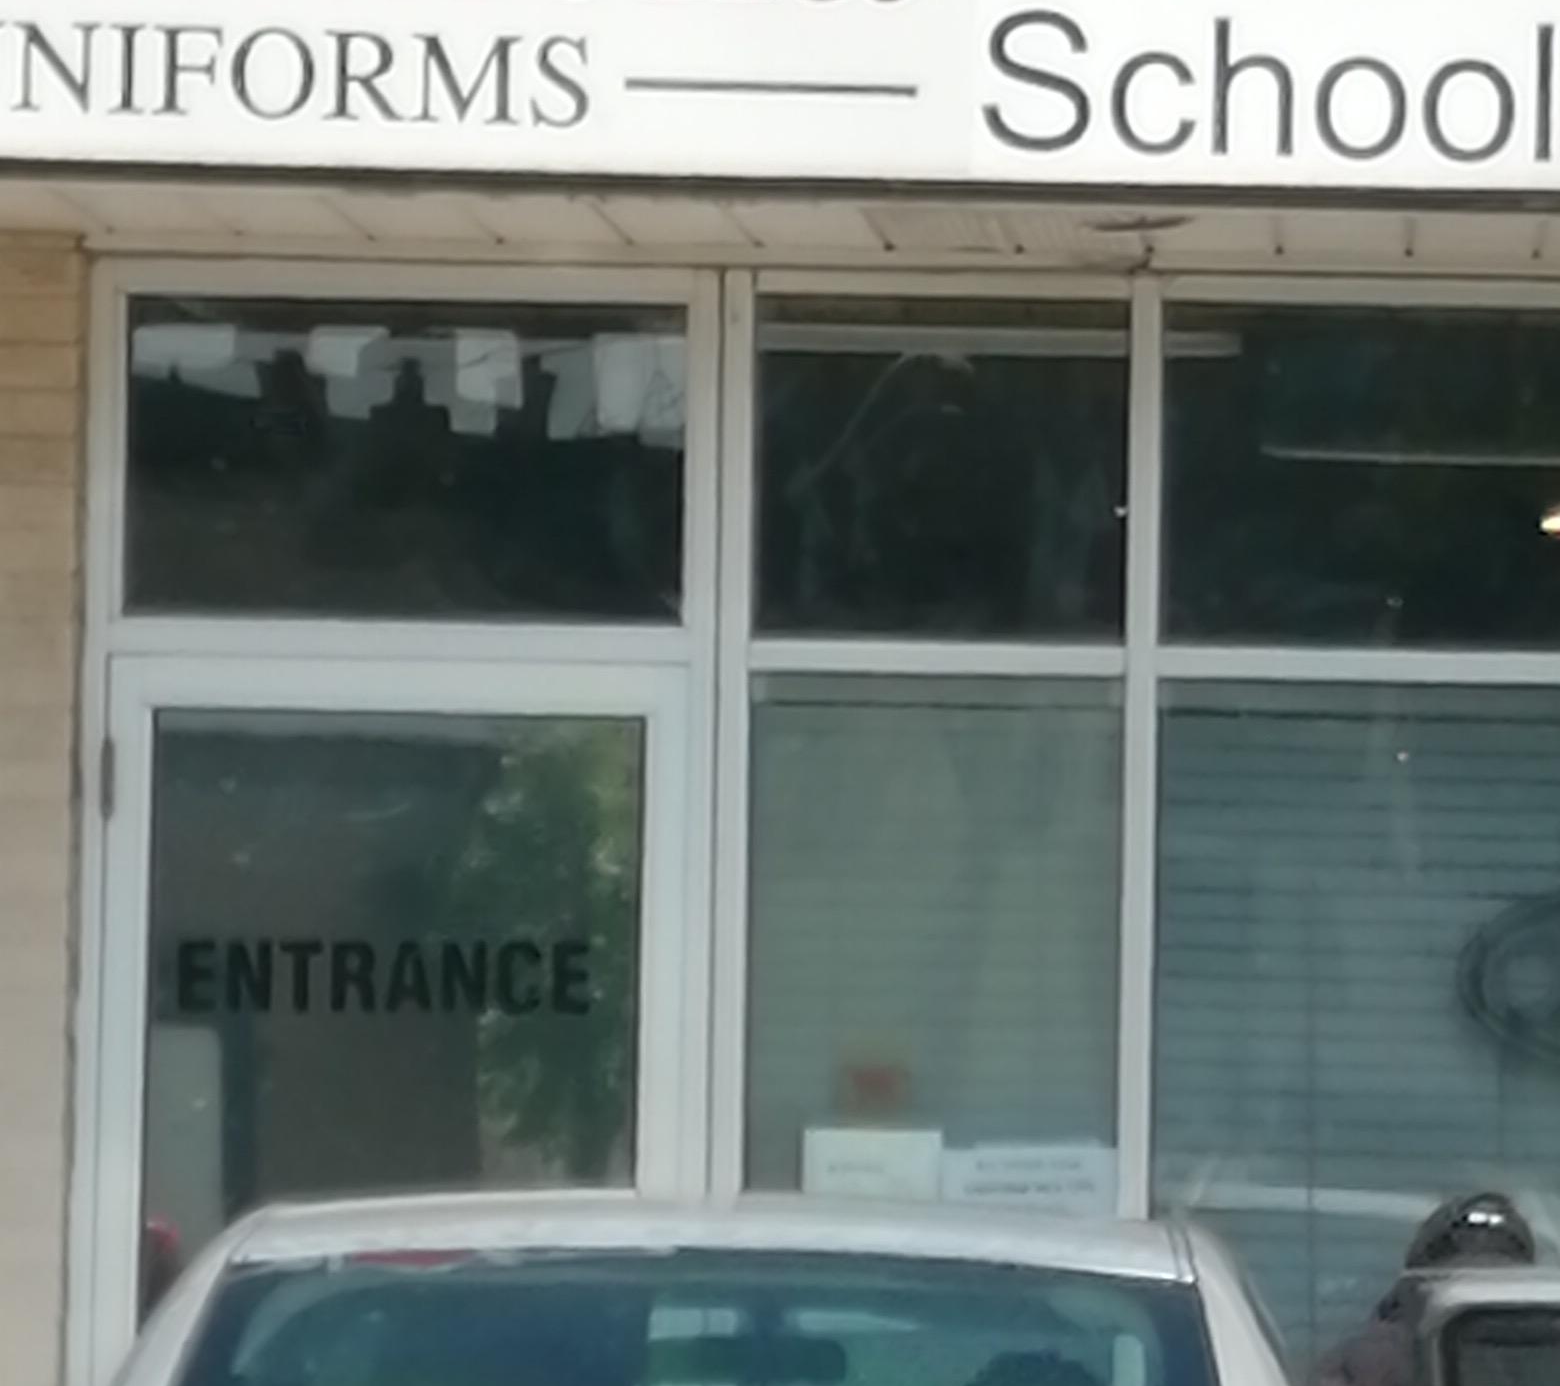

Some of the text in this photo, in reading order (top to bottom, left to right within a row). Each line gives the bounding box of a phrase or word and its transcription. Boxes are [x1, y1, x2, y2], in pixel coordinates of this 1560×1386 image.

[0, 21, 589, 128] NIFORMS
[982, 10, 1554, 163] School
[176, 938, 592, 1015] ENTRANCE
